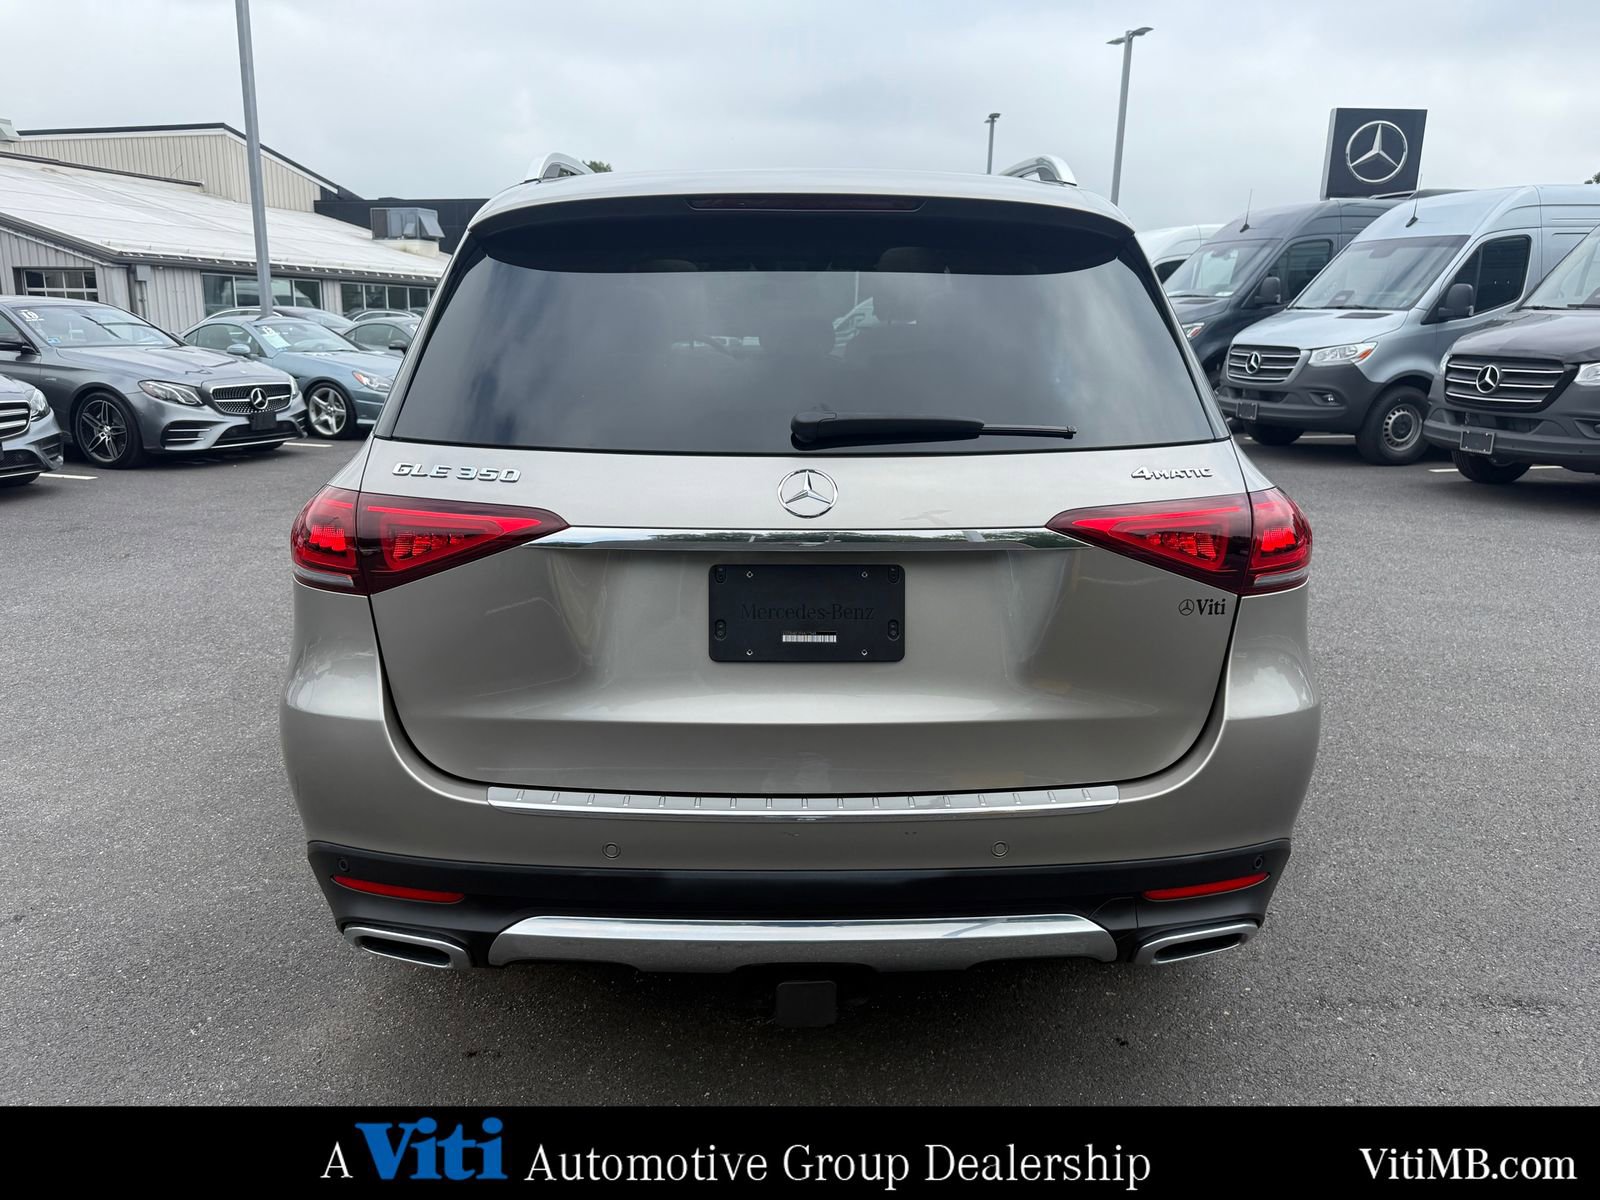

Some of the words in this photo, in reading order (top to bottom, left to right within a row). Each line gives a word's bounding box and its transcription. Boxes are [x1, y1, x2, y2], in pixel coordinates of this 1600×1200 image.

[391, 462, 452, 479] GLE
[456, 466, 522, 484] 350
[1131, 464, 1216, 481] 4MATIC
[740, 603, 875, 621] Mercedes-Benz
[1196, 599, 1226, 616] Viti
